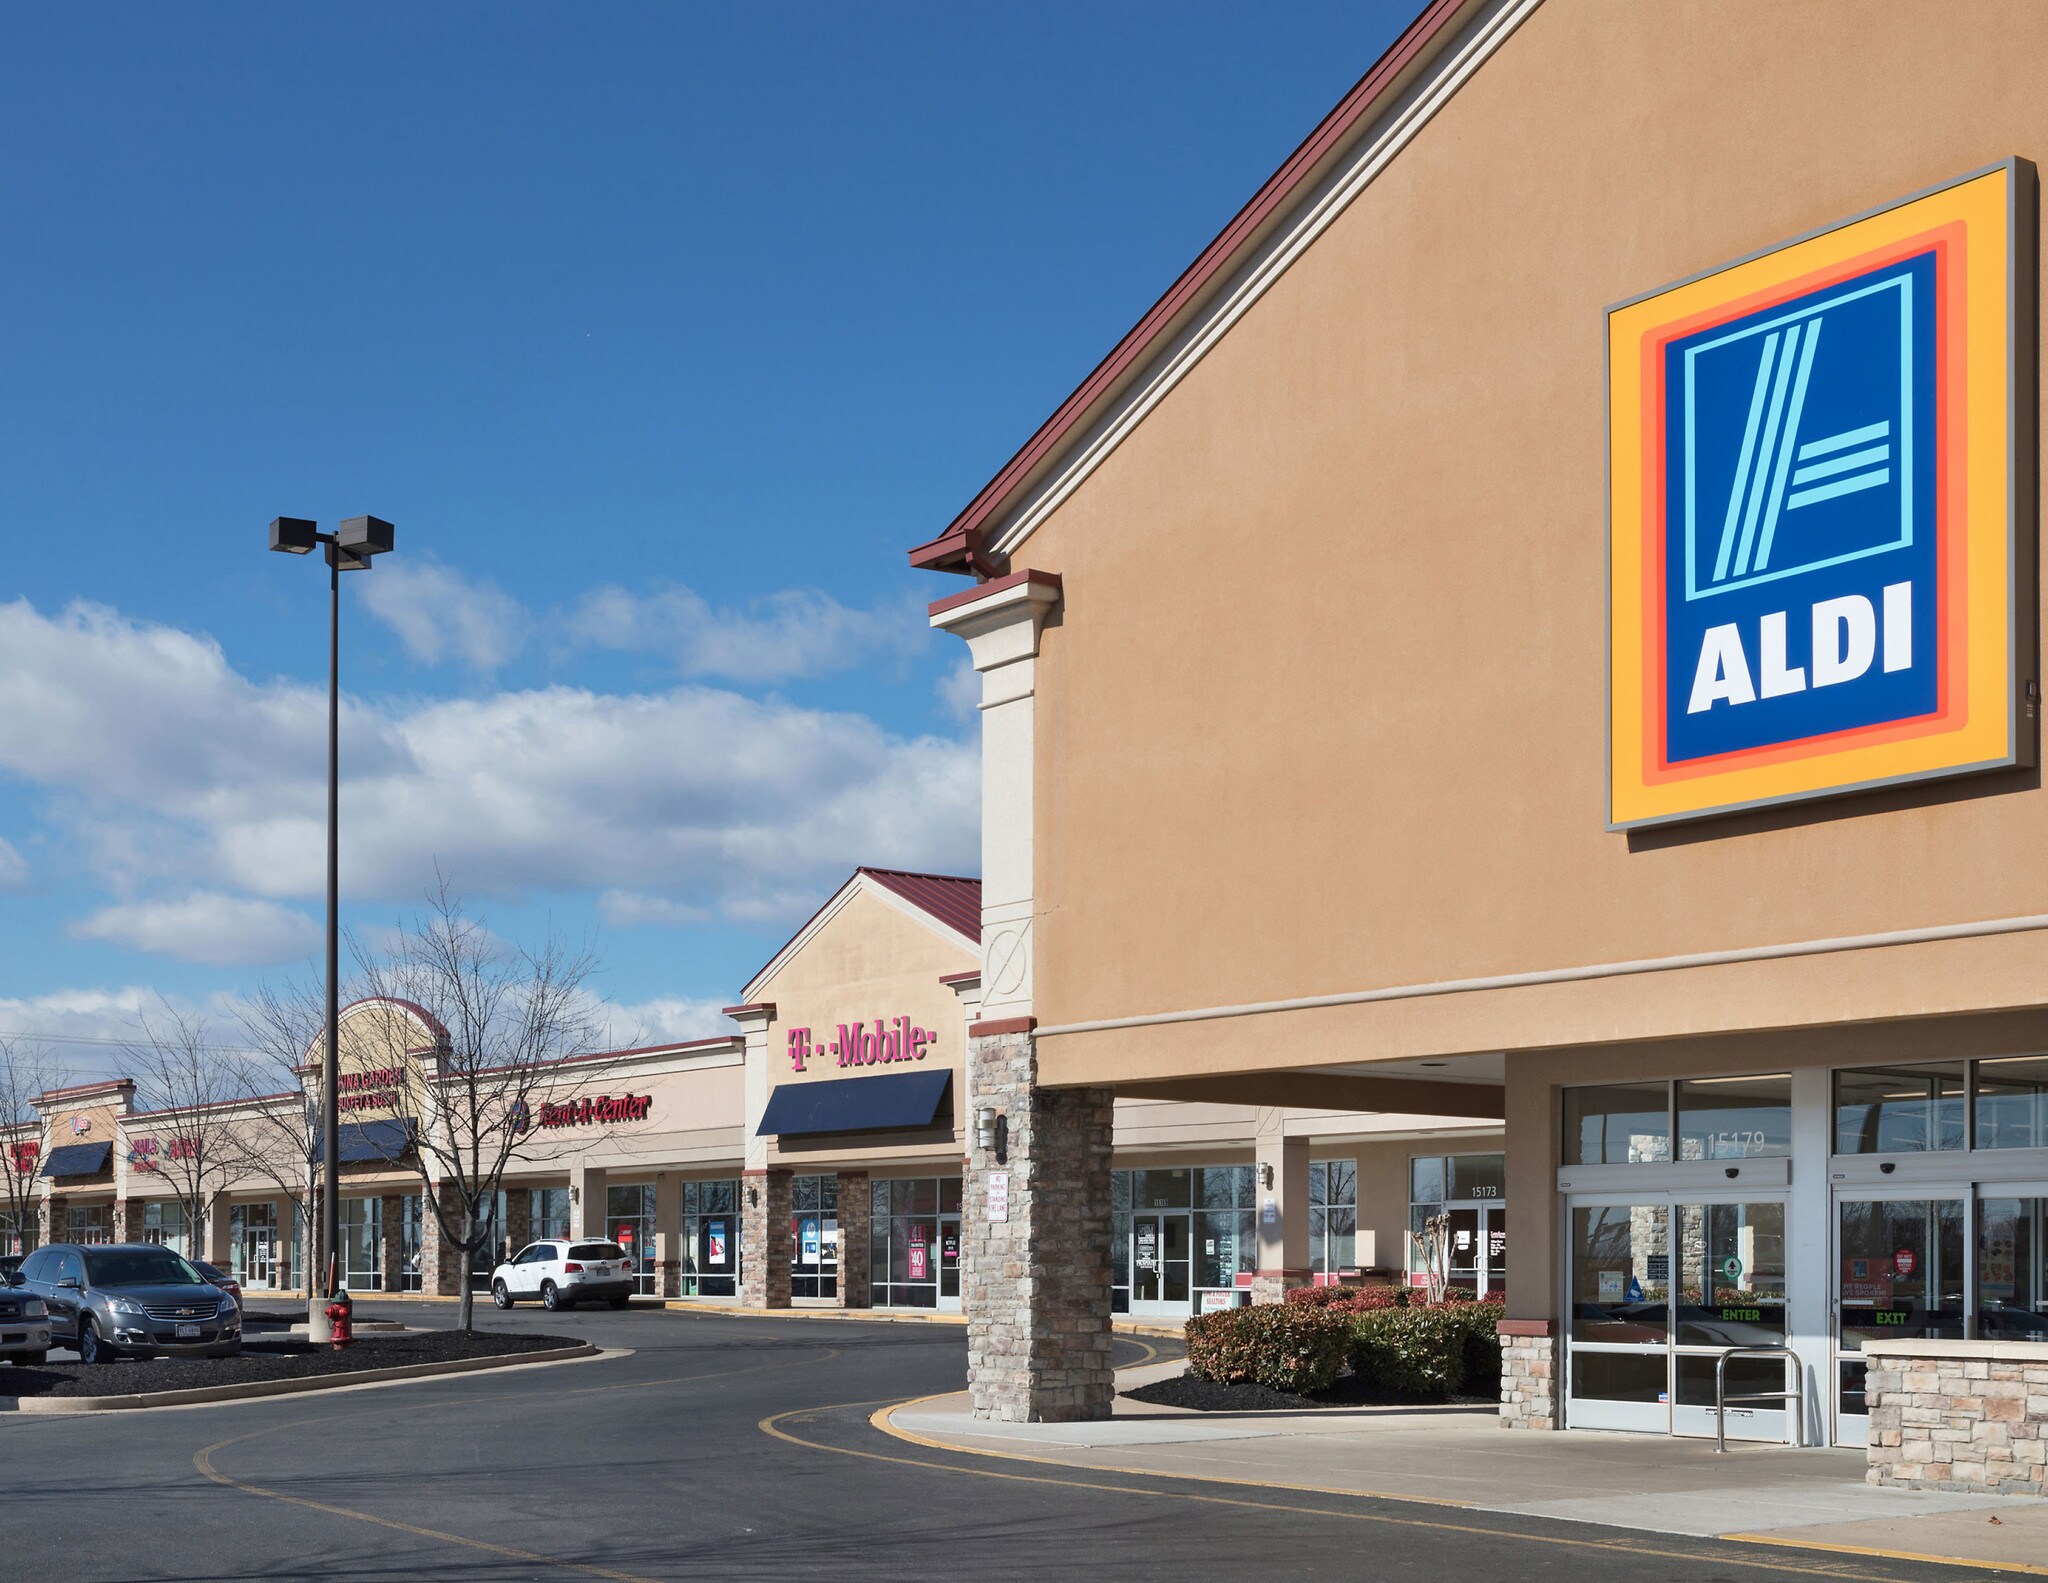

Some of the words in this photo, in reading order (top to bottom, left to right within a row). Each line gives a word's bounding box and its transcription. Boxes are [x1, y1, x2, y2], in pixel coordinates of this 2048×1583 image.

[1687, 580, 1912, 714] ALDI
[338, 1073, 359, 1091] HINA
[1708, 1131, 1765, 1153] 15179
[1472, 1186, 1497, 1198] 15173
[1722, 1308, 1761, 1321] ENTER
[1876, 1312, 1906, 1325] EXIT
